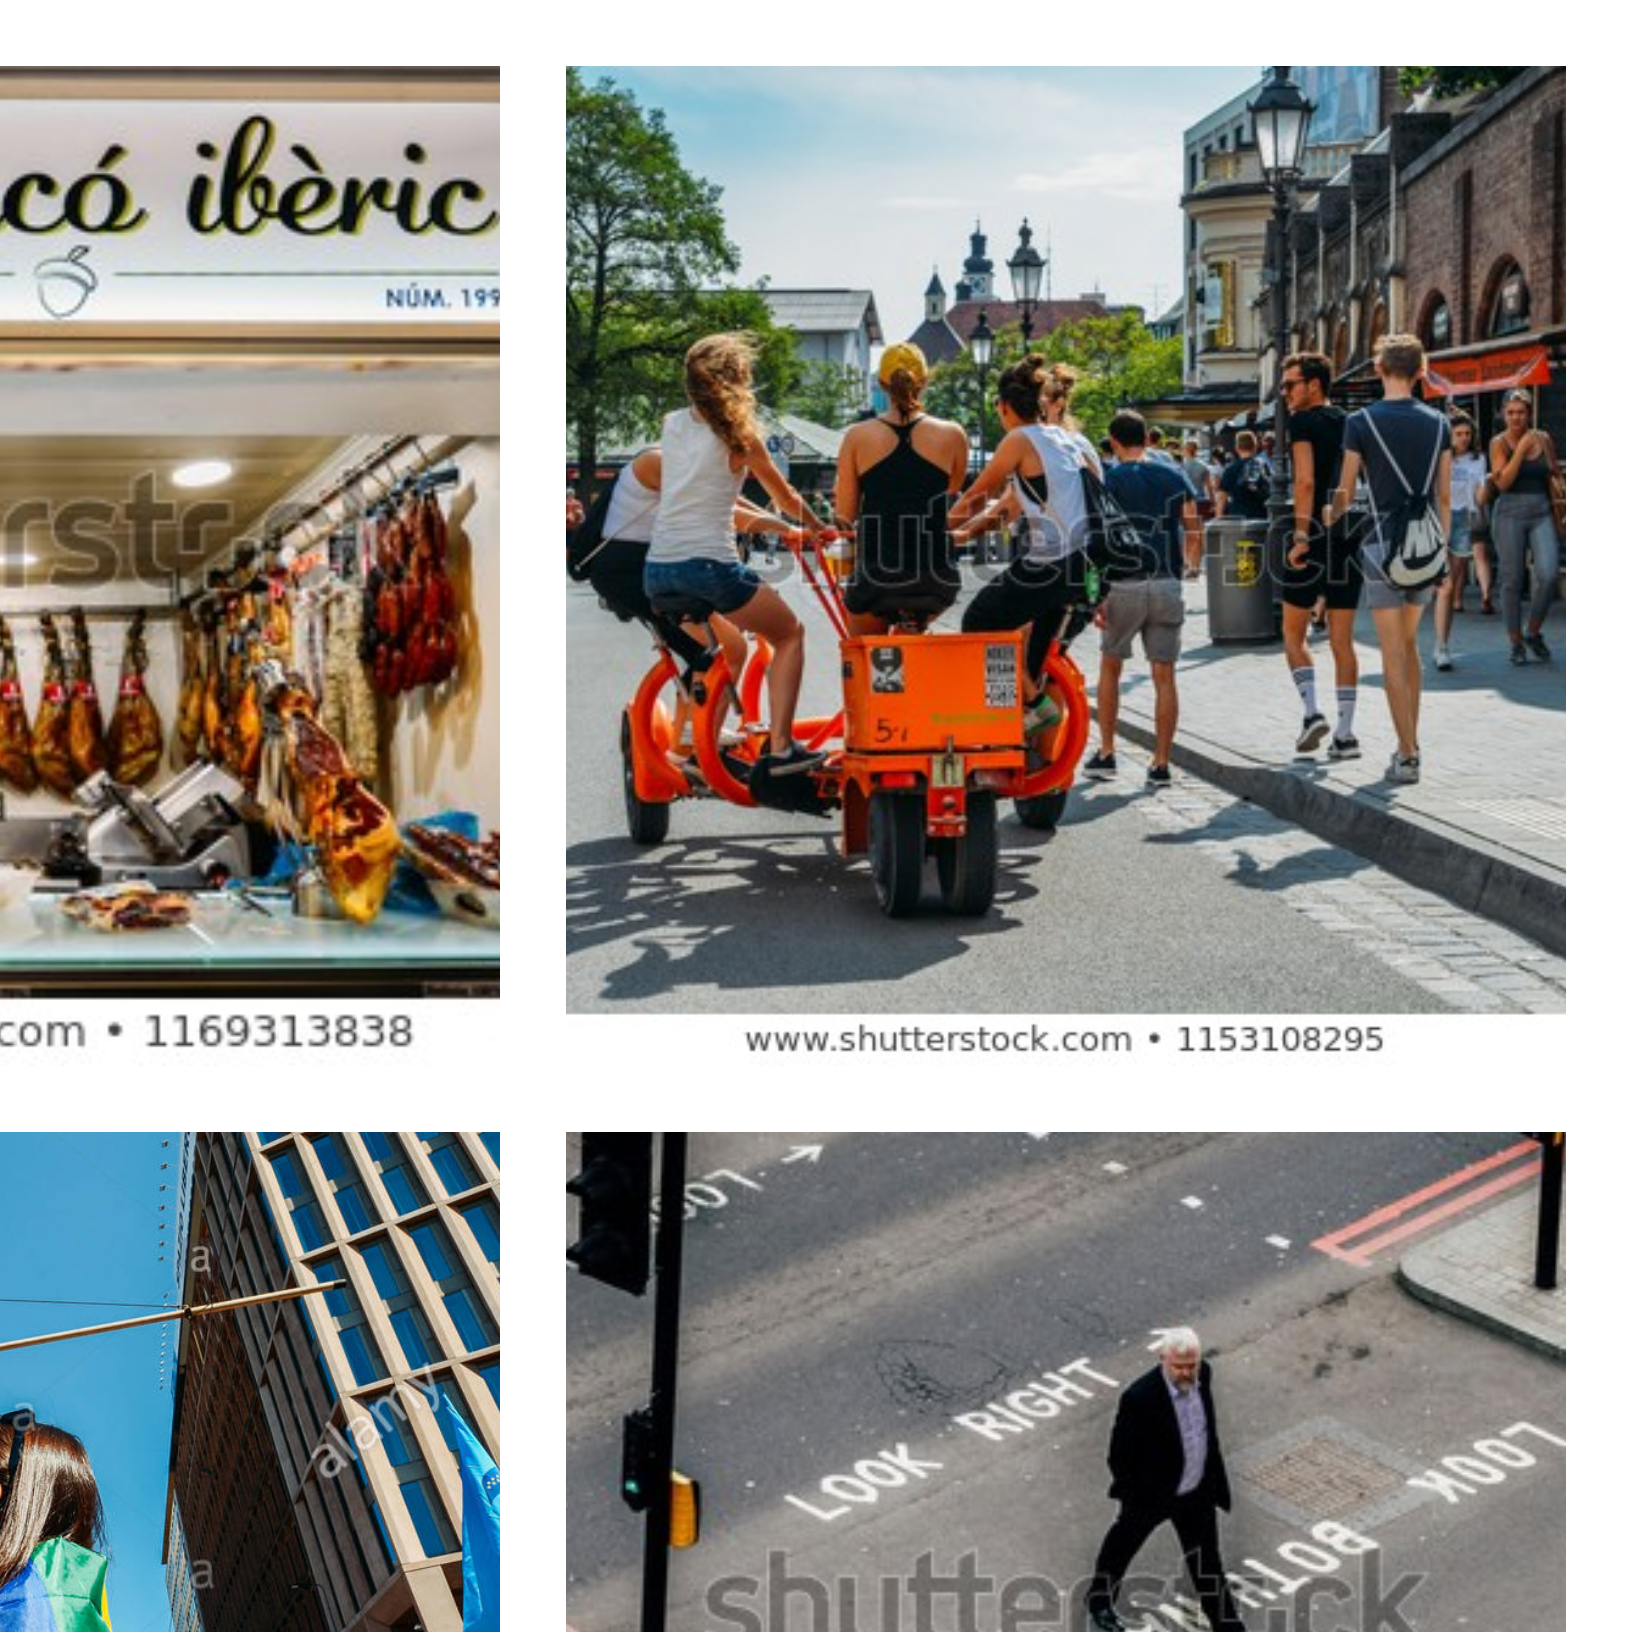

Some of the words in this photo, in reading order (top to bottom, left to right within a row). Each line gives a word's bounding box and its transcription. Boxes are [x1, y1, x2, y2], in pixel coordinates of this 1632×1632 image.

[185, 114, 500, 236] ibèric
[784, 1443, 944, 1521] LOOK
[953, 1357, 1120, 1442] RIGHT
[1407, 1421, 1566, 1503] LOOK
[1224, 1520, 1380, 1608] BOTH
